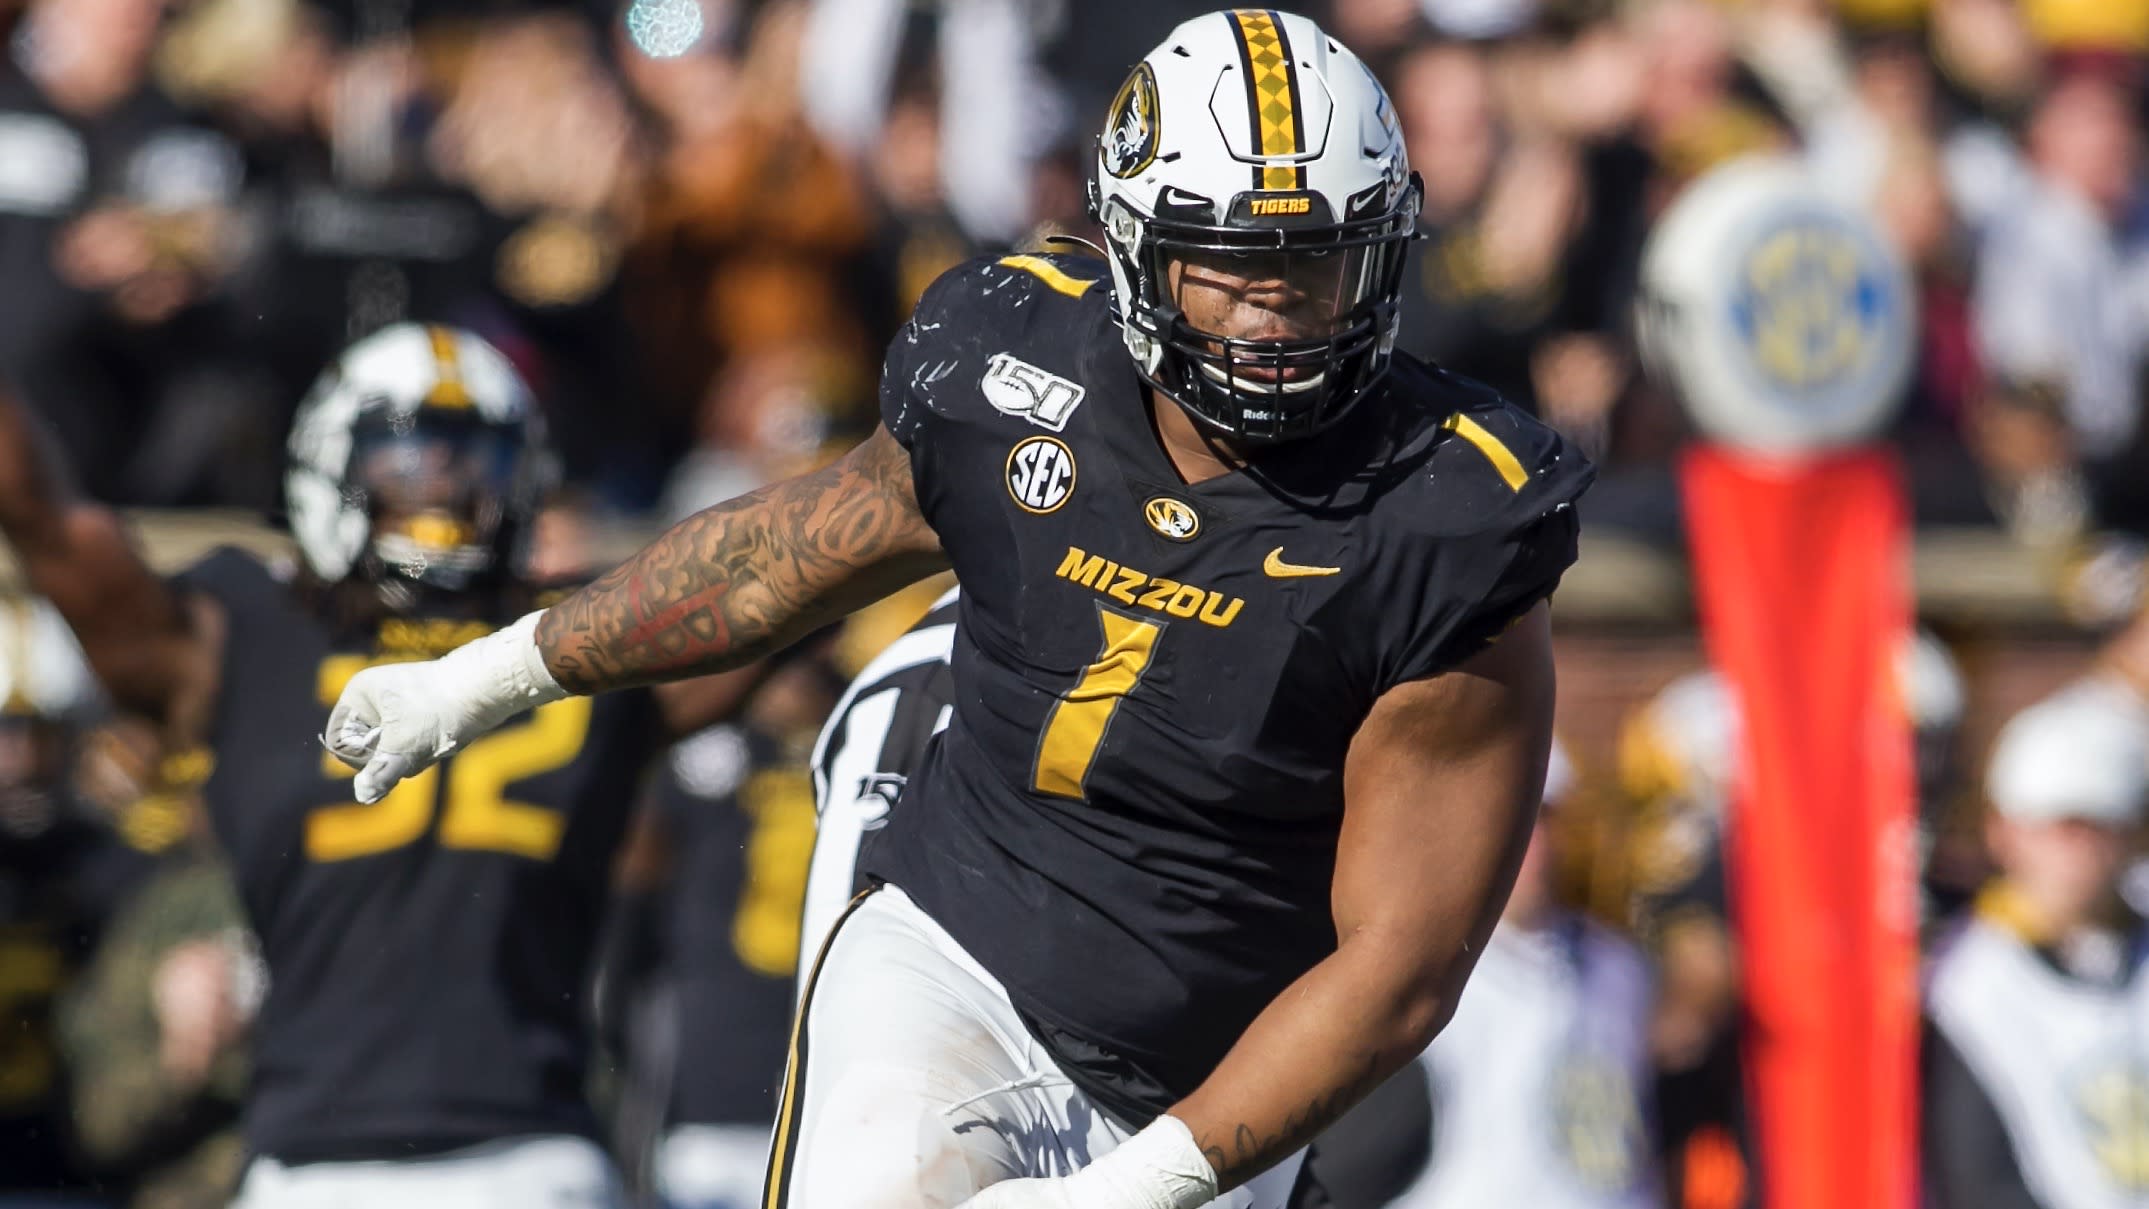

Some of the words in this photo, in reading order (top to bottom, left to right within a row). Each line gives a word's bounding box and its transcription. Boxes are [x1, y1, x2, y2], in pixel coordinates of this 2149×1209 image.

[1250, 197, 1310, 215] TIGERS
[981, 353, 1087, 433] 150
[1011, 441, 1072, 508] SEC
[1055, 545, 1245, 628] MIZZOU
[1030, 599, 1169, 804] 1
